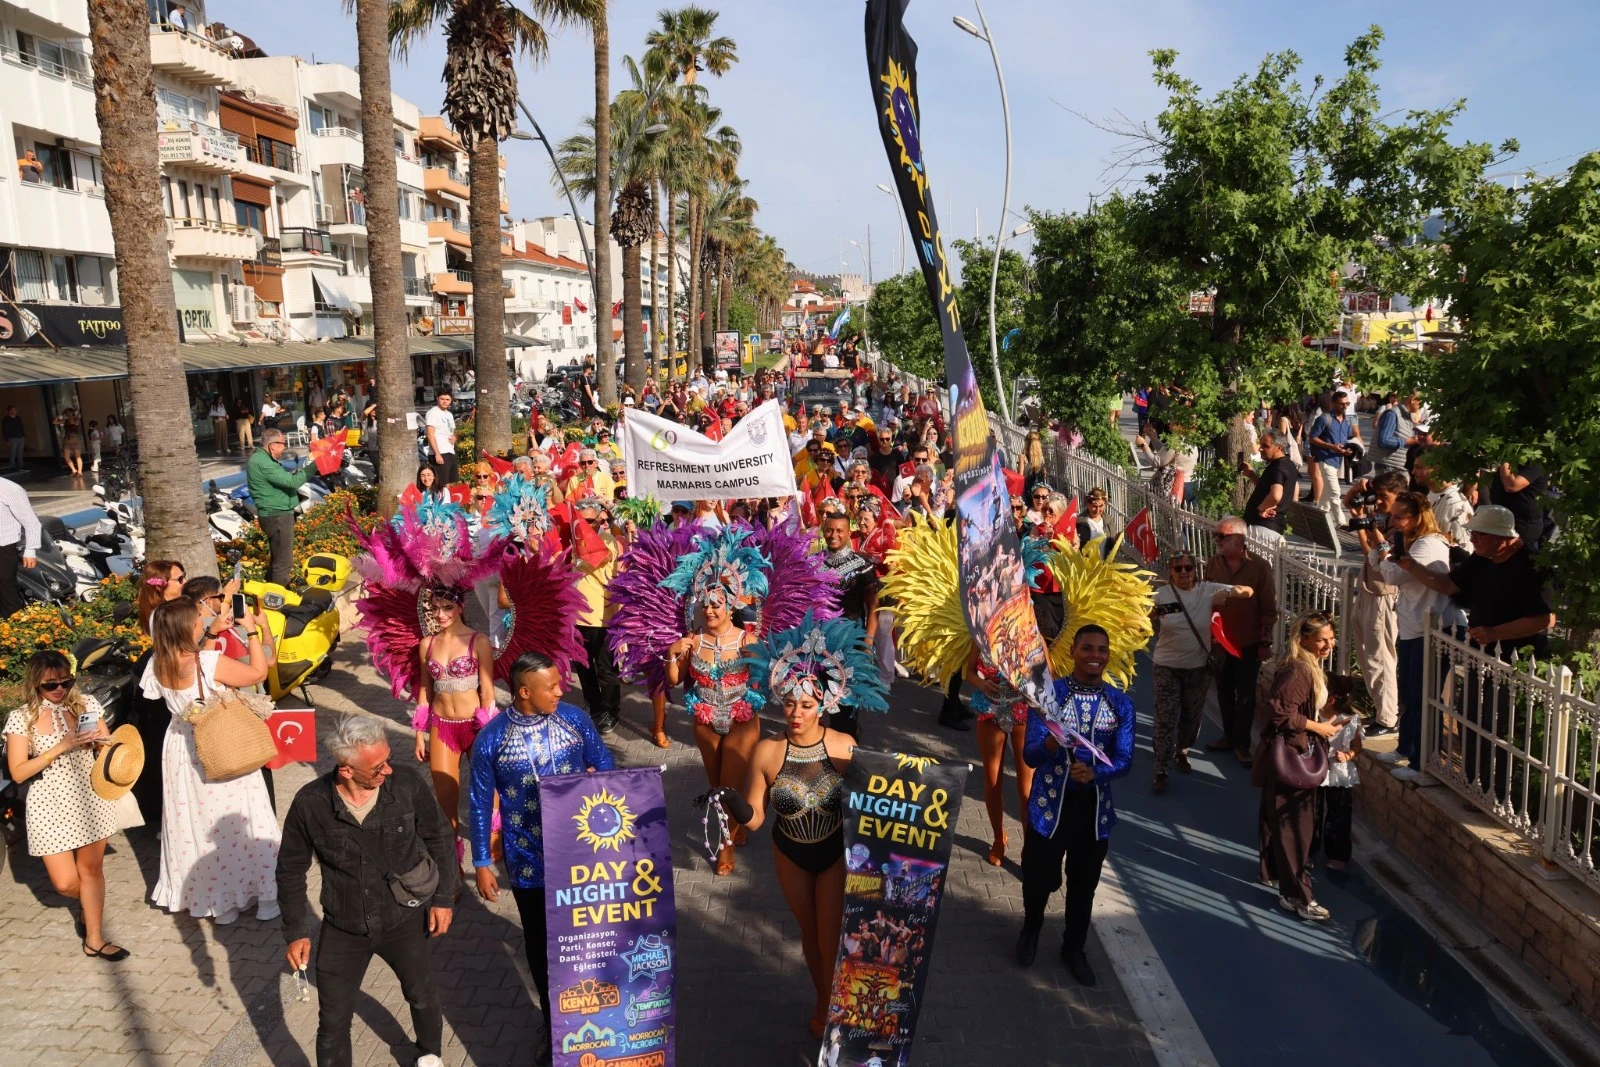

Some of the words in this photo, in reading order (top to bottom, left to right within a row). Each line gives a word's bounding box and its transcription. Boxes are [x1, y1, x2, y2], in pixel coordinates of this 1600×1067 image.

[78, 320, 120, 339] TATTOO
[637, 459, 710, 474] REFRESHMENT
[714, 453, 774, 473] UNIVERSITY
[657, 479, 712, 490] MARMARIS
[714, 476, 760, 489] CAMPUS
[849, 791, 921, 822] NIGHT
[867, 775, 927, 802] DAY
[923, 788, 949, 829] &
[857, 815, 942, 851] EVENT
[570, 860, 628, 885] DAY
[632, 858, 663, 897] &
[556, 882, 629, 907] NIGHT
[572, 898, 658, 927] EVENT
[561, 944, 584, 953] Parti,
[586, 940, 617, 949] Konser,
[559, 953, 583, 963] Dans,
[631, 950, 667, 963] MICHAEL
[573, 961, 607, 973] Eğlence
[632, 958, 668, 972] JACKSON
[562, 995, 600, 1010] KENYA
[635, 998, 671, 1011] TEMPTATION
[581, 1006, 600, 1015] SHOW
[568, 1040, 611, 1053] MORROCAN
